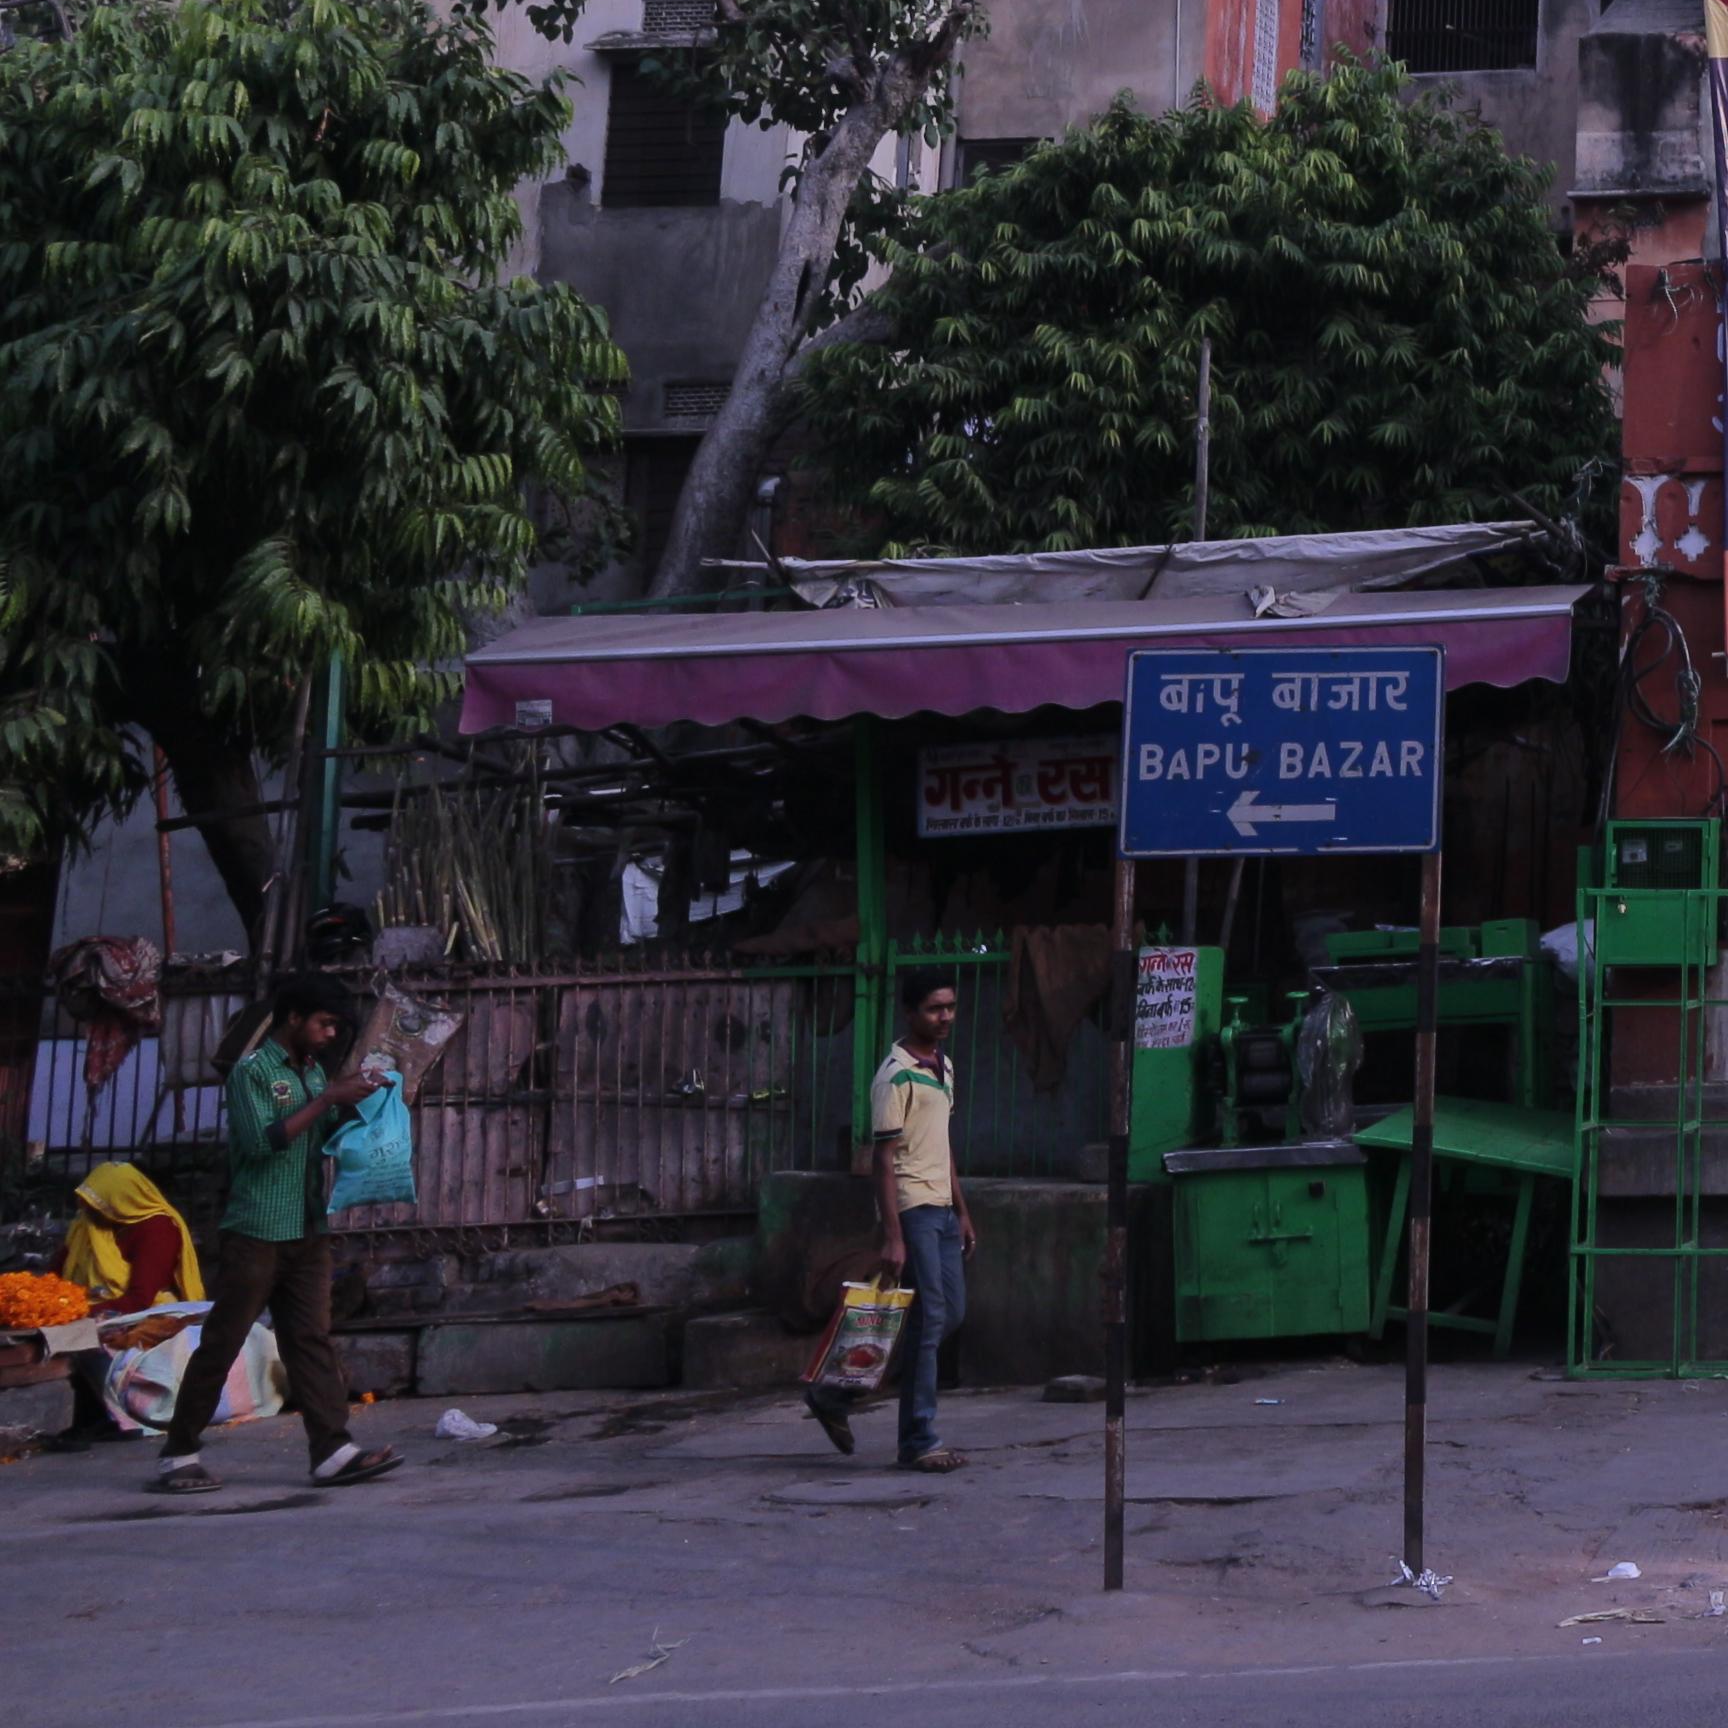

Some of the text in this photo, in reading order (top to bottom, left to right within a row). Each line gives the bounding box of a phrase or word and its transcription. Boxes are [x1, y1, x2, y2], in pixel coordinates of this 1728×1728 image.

[1159, 671, 1410, 727] बापू बाजार
[924, 755, 1017, 811] गन्ने
[1038, 756, 1114, 805] रस
[1139, 740, 1425, 781] BAPU BAZAR
